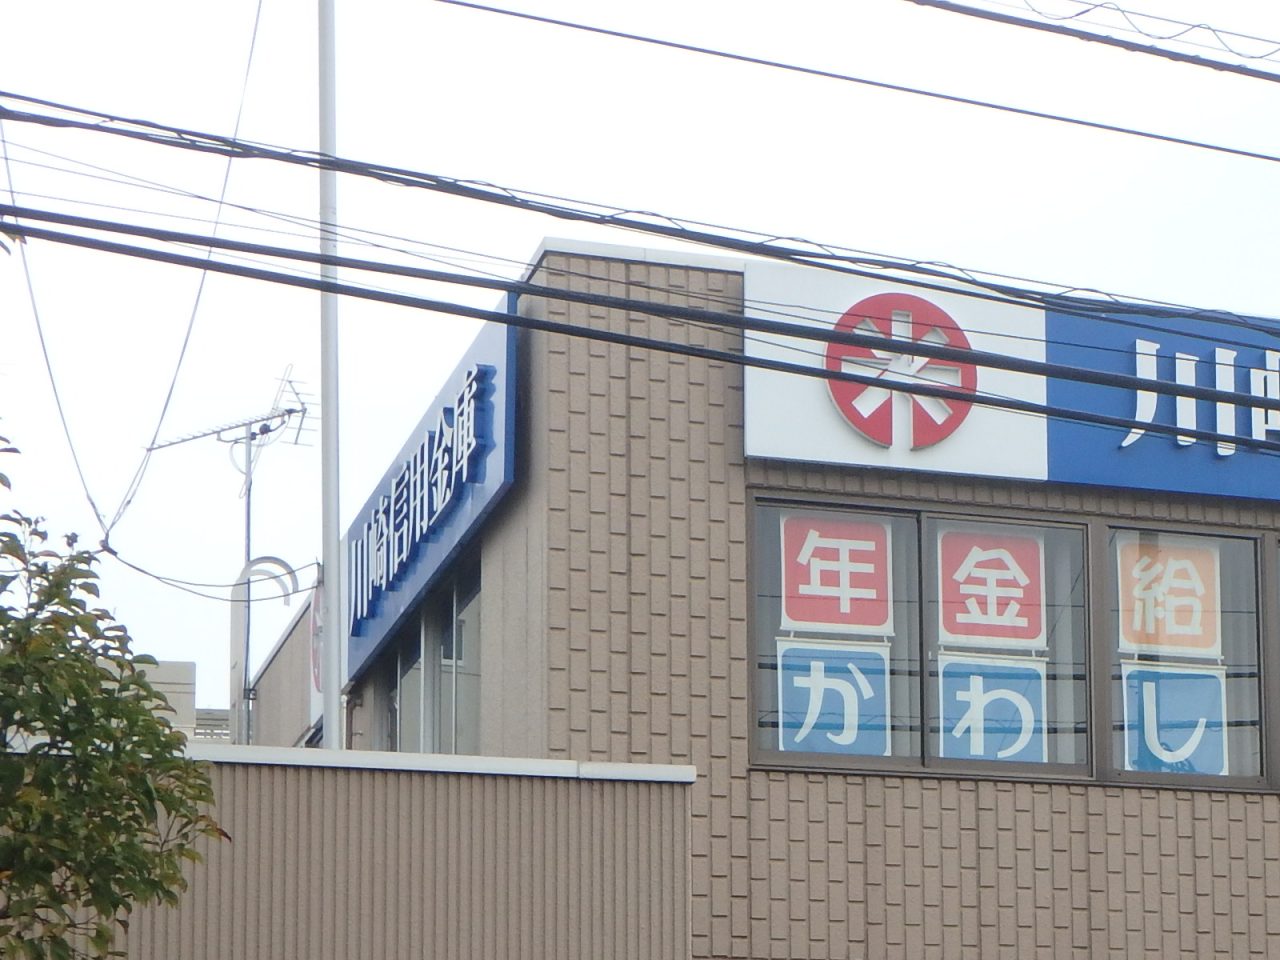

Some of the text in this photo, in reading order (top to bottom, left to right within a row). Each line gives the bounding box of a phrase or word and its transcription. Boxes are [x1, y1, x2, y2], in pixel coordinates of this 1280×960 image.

[351, 363, 482, 637] 川崎信用金庫
